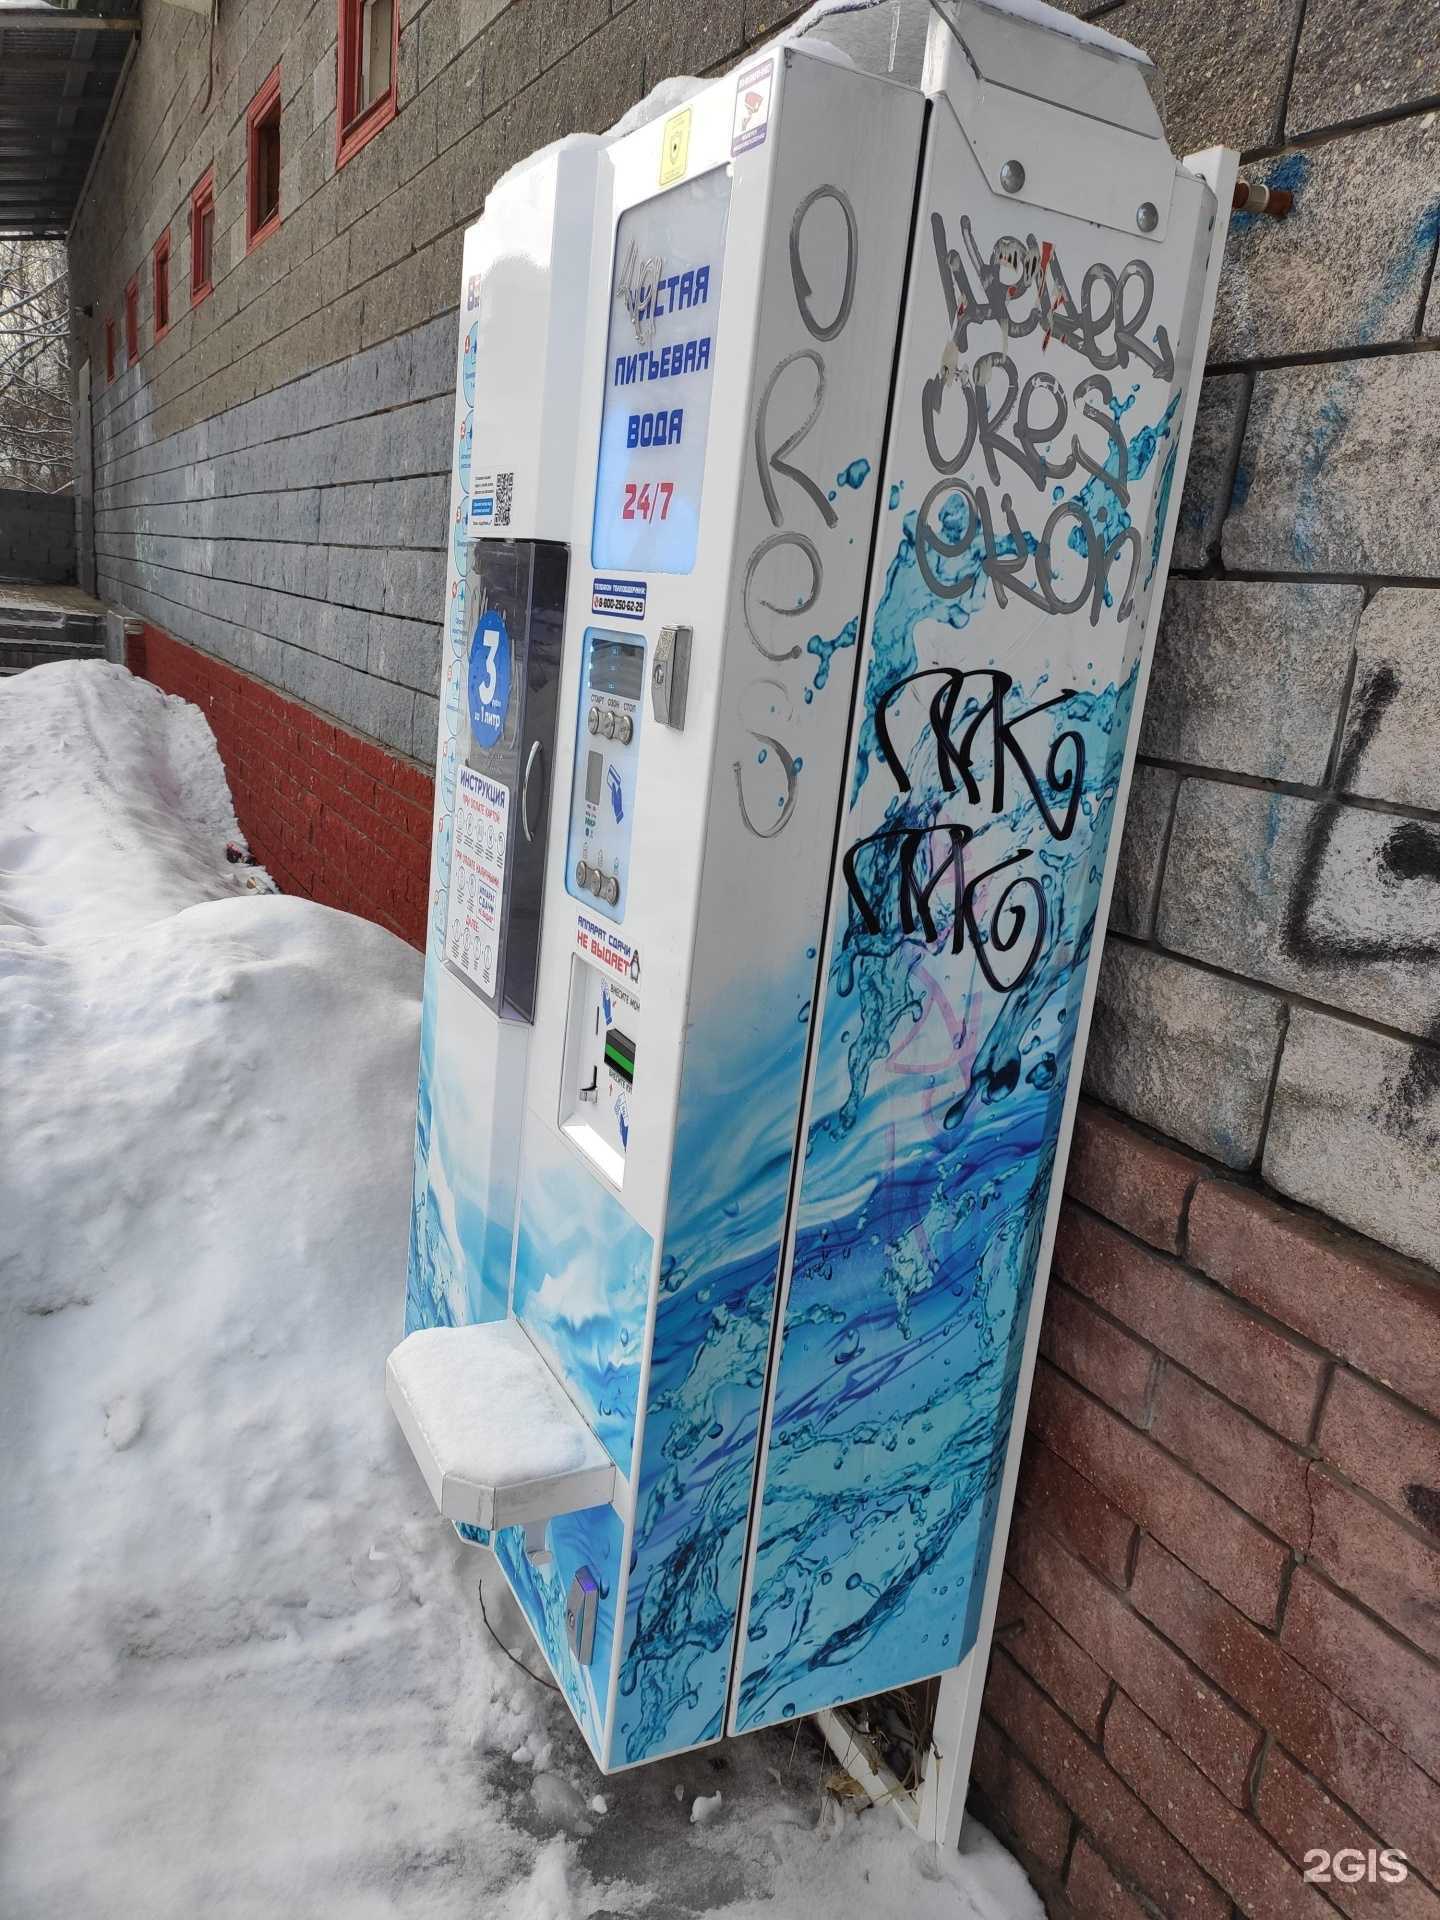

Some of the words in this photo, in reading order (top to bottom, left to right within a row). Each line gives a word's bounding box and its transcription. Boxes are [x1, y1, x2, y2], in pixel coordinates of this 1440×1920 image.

[614, 337, 711, 386] ПИТЬЕВАЯ
[626, 409, 684, 449] ВОДА
[622, 482, 674, 524] 24/7
[479, 629, 500, 704] 3
[484, 711, 501, 731] литр
[460, 768, 506, 808] ИНСТРУКЦИЯ
[577, 915, 607, 941] АППАРАТ
[608, 934, 631, 958] СДАЧИ
[577, 929, 588, 950] НЕ
[590, 939, 630, 976] ВЫДАЕТ
